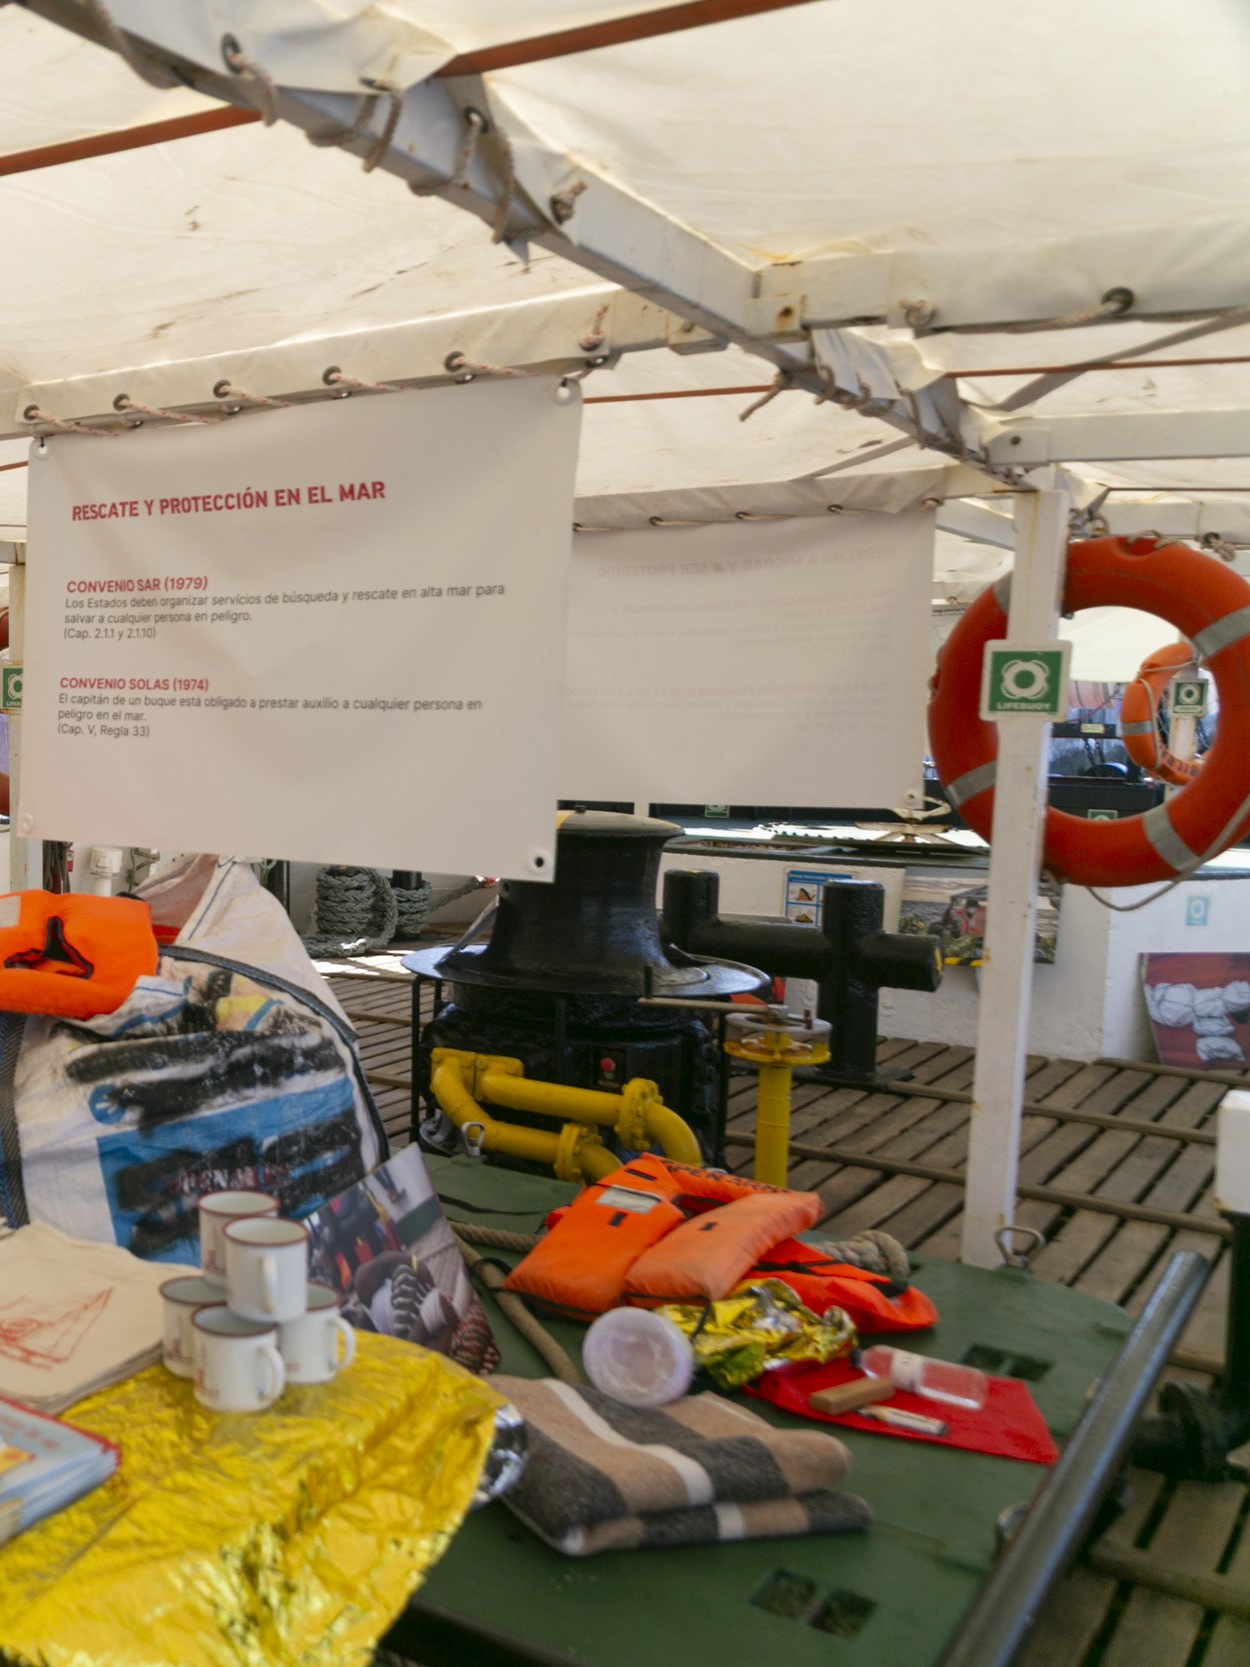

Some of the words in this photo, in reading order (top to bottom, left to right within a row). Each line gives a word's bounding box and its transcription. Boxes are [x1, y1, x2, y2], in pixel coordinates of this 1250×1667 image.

[71, 501, 139, 521] RESCATE
[144, 499, 154, 516] Y
[159, 486, 268, 515] PROTECCIÓN
[274, 488, 301, 507] EN
[307, 486, 333, 504] EL
[338, 481, 386, 502] MAR
[66, 580, 135, 593] CONVENIO
[137, 578, 160, 592] SAR
[164, 575, 209, 592] (1979)
[65, 598, 85, 609] Los
[87, 597, 128, 609] Estados
[130, 596, 158, 608] deben
[160, 594, 208, 609] organizar
[211, 594, 262, 606] servicios
[264, 593, 279, 604] de
[282, 590, 339, 605] búsqueda
[342, 592, 349, 604] y
[351, 588, 398, 600] rescate
[401, 588, 417, 599] en
[420, 585, 443, 599] alta
[446, 585, 472, 597] mar
[475, 584, 505, 598] para
[64, 613, 96, 624] salvar
[98, 614, 105, 623] a
[107, 612, 152, 625] cualquier
[154, 612, 191, 625] persona
[194, 612, 208, 622] en
[210, 610, 253, 624] peligro.
[63, 626, 92, 641] (Cap.
[94, 627, 115, 639] 2.1.1
[117, 629, 125, 641] y
[126, 627, 157, 640] 2.1.10)
[60, 677, 126, 690] CONVENIO
[129, 678, 170, 691] SOLAS
[172, 677, 209, 692] (1974)
[59, 693, 68, 704] El
[70, 693, 109, 706] capitán
[112, 694, 126, 706] de
[129, 696, 141, 706] un
[144, 695, 176, 708] buque
[179, 695, 201, 707] está
[203, 696, 247, 710] obligado
[250, 698, 256, 709] a
[259, 698, 299, 711] prestar
[302, 697, 339, 709] auxilio
[342, 699, 350, 709] a
[352, 697, 410, 712] cualquier
[413, 699, 463, 713] persona
[467, 700, 482, 710] en
[996, 701, 1052, 711] LIFEBUOY
[58, 708, 93, 722] peligro
[96, 711, 109, 720] en
[112, 710, 122, 720] el
[124, 711, 147, 721] mar.
[57, 723, 84, 736] (Cap.
[88, 724, 97, 737] V,
[100, 724, 129, 739] Regla
[132, 725, 150, 738] 33)
